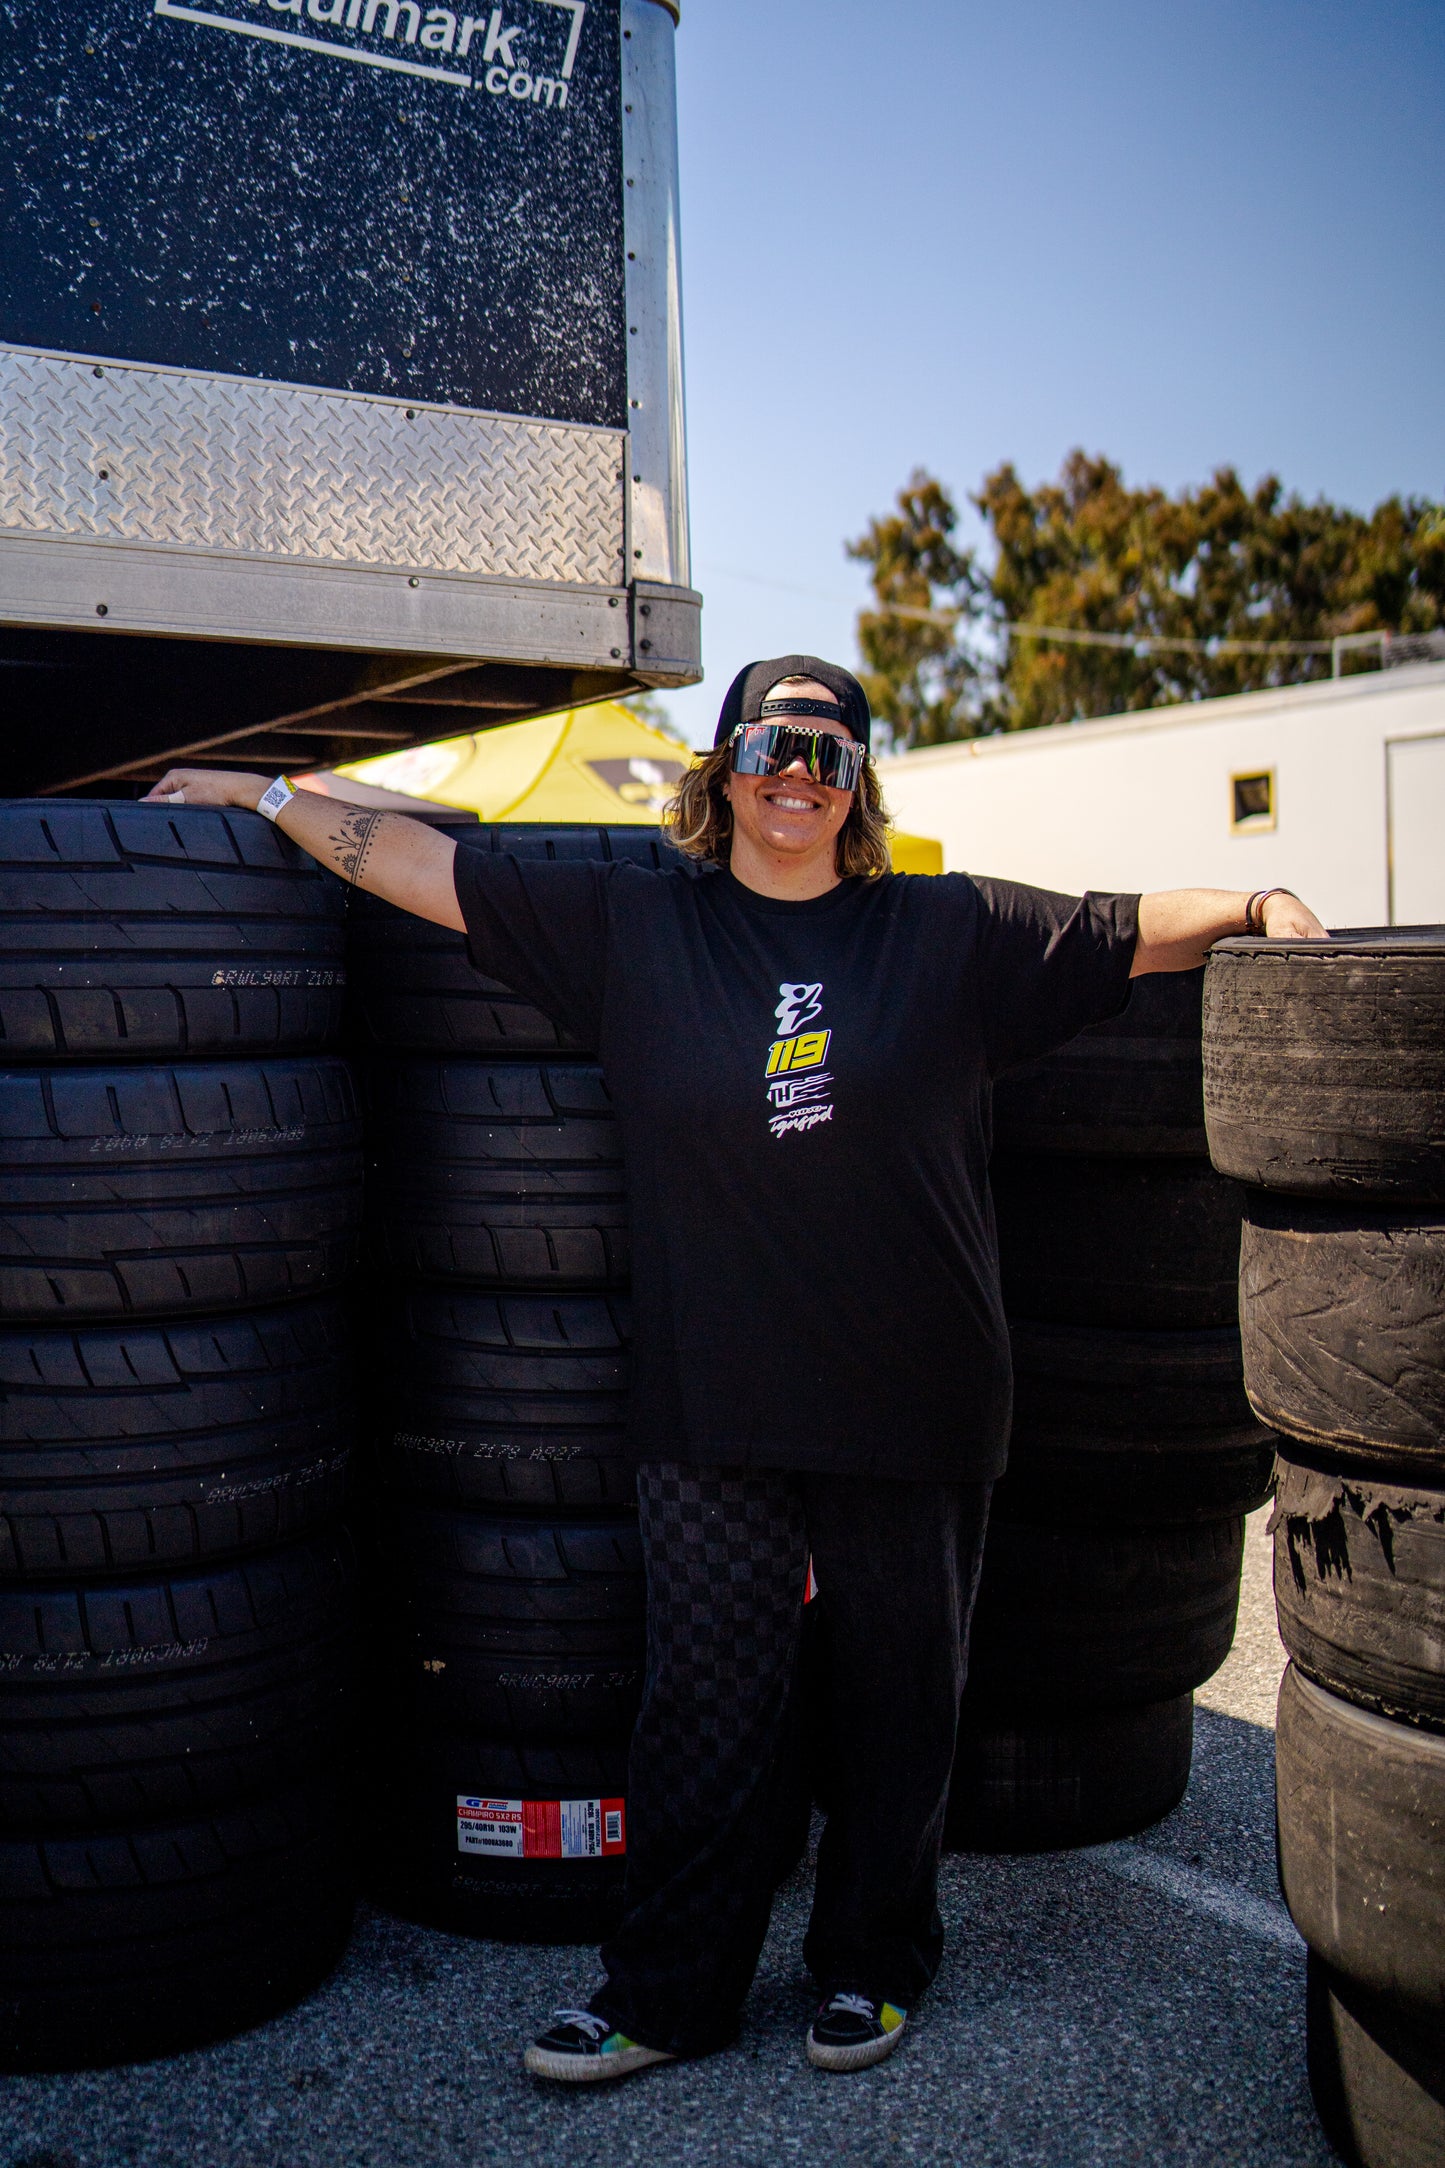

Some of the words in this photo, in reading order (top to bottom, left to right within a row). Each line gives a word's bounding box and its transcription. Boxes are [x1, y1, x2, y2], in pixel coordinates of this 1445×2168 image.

[474, 66, 569, 108] .com
[766, 1030, 830, 1076] 119
[458, 1808, 495, 1819] CHAMPIRO
[511, 1813, 522, 1821] RS
[498, 1824, 517, 1834] 103W
